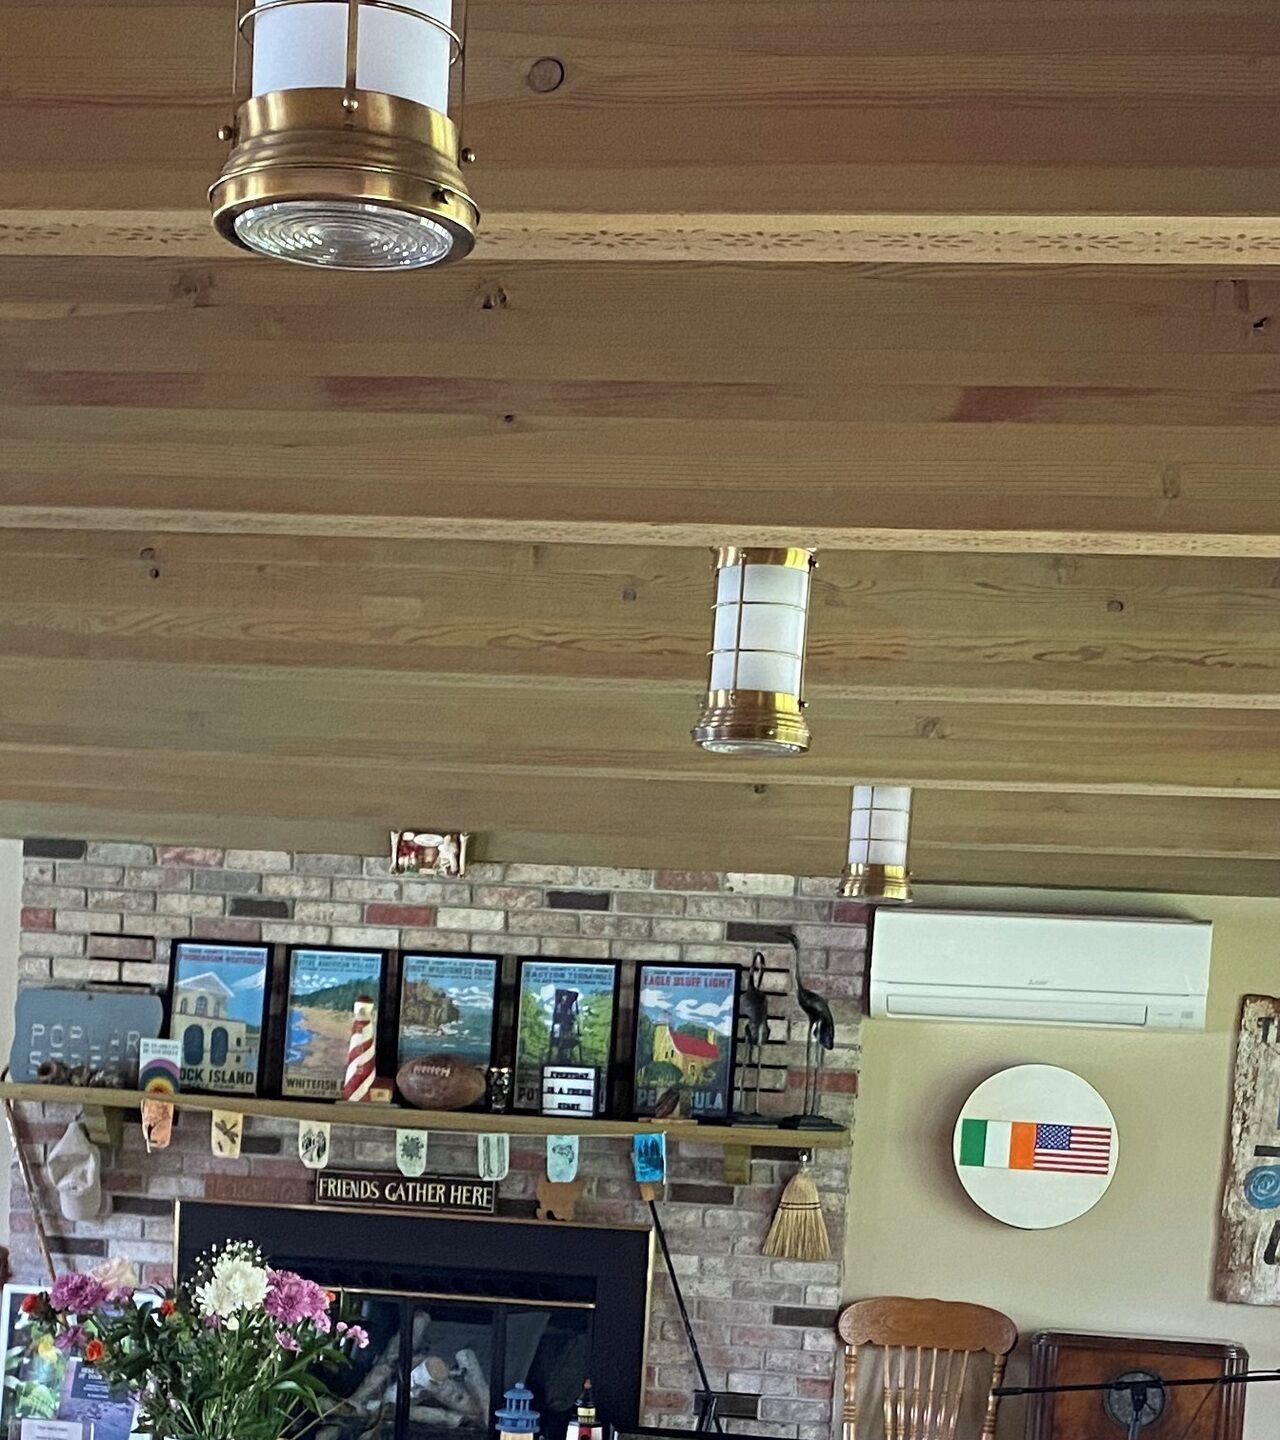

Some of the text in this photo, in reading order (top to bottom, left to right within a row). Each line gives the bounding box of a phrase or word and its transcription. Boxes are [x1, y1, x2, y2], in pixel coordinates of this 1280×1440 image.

[179, 1067, 255, 1085] OCK ISLAND
[286, 1078, 338, 1091] WHITEFISH
[319, 1178, 493, 1207] FRIENDS GATHER HERE
